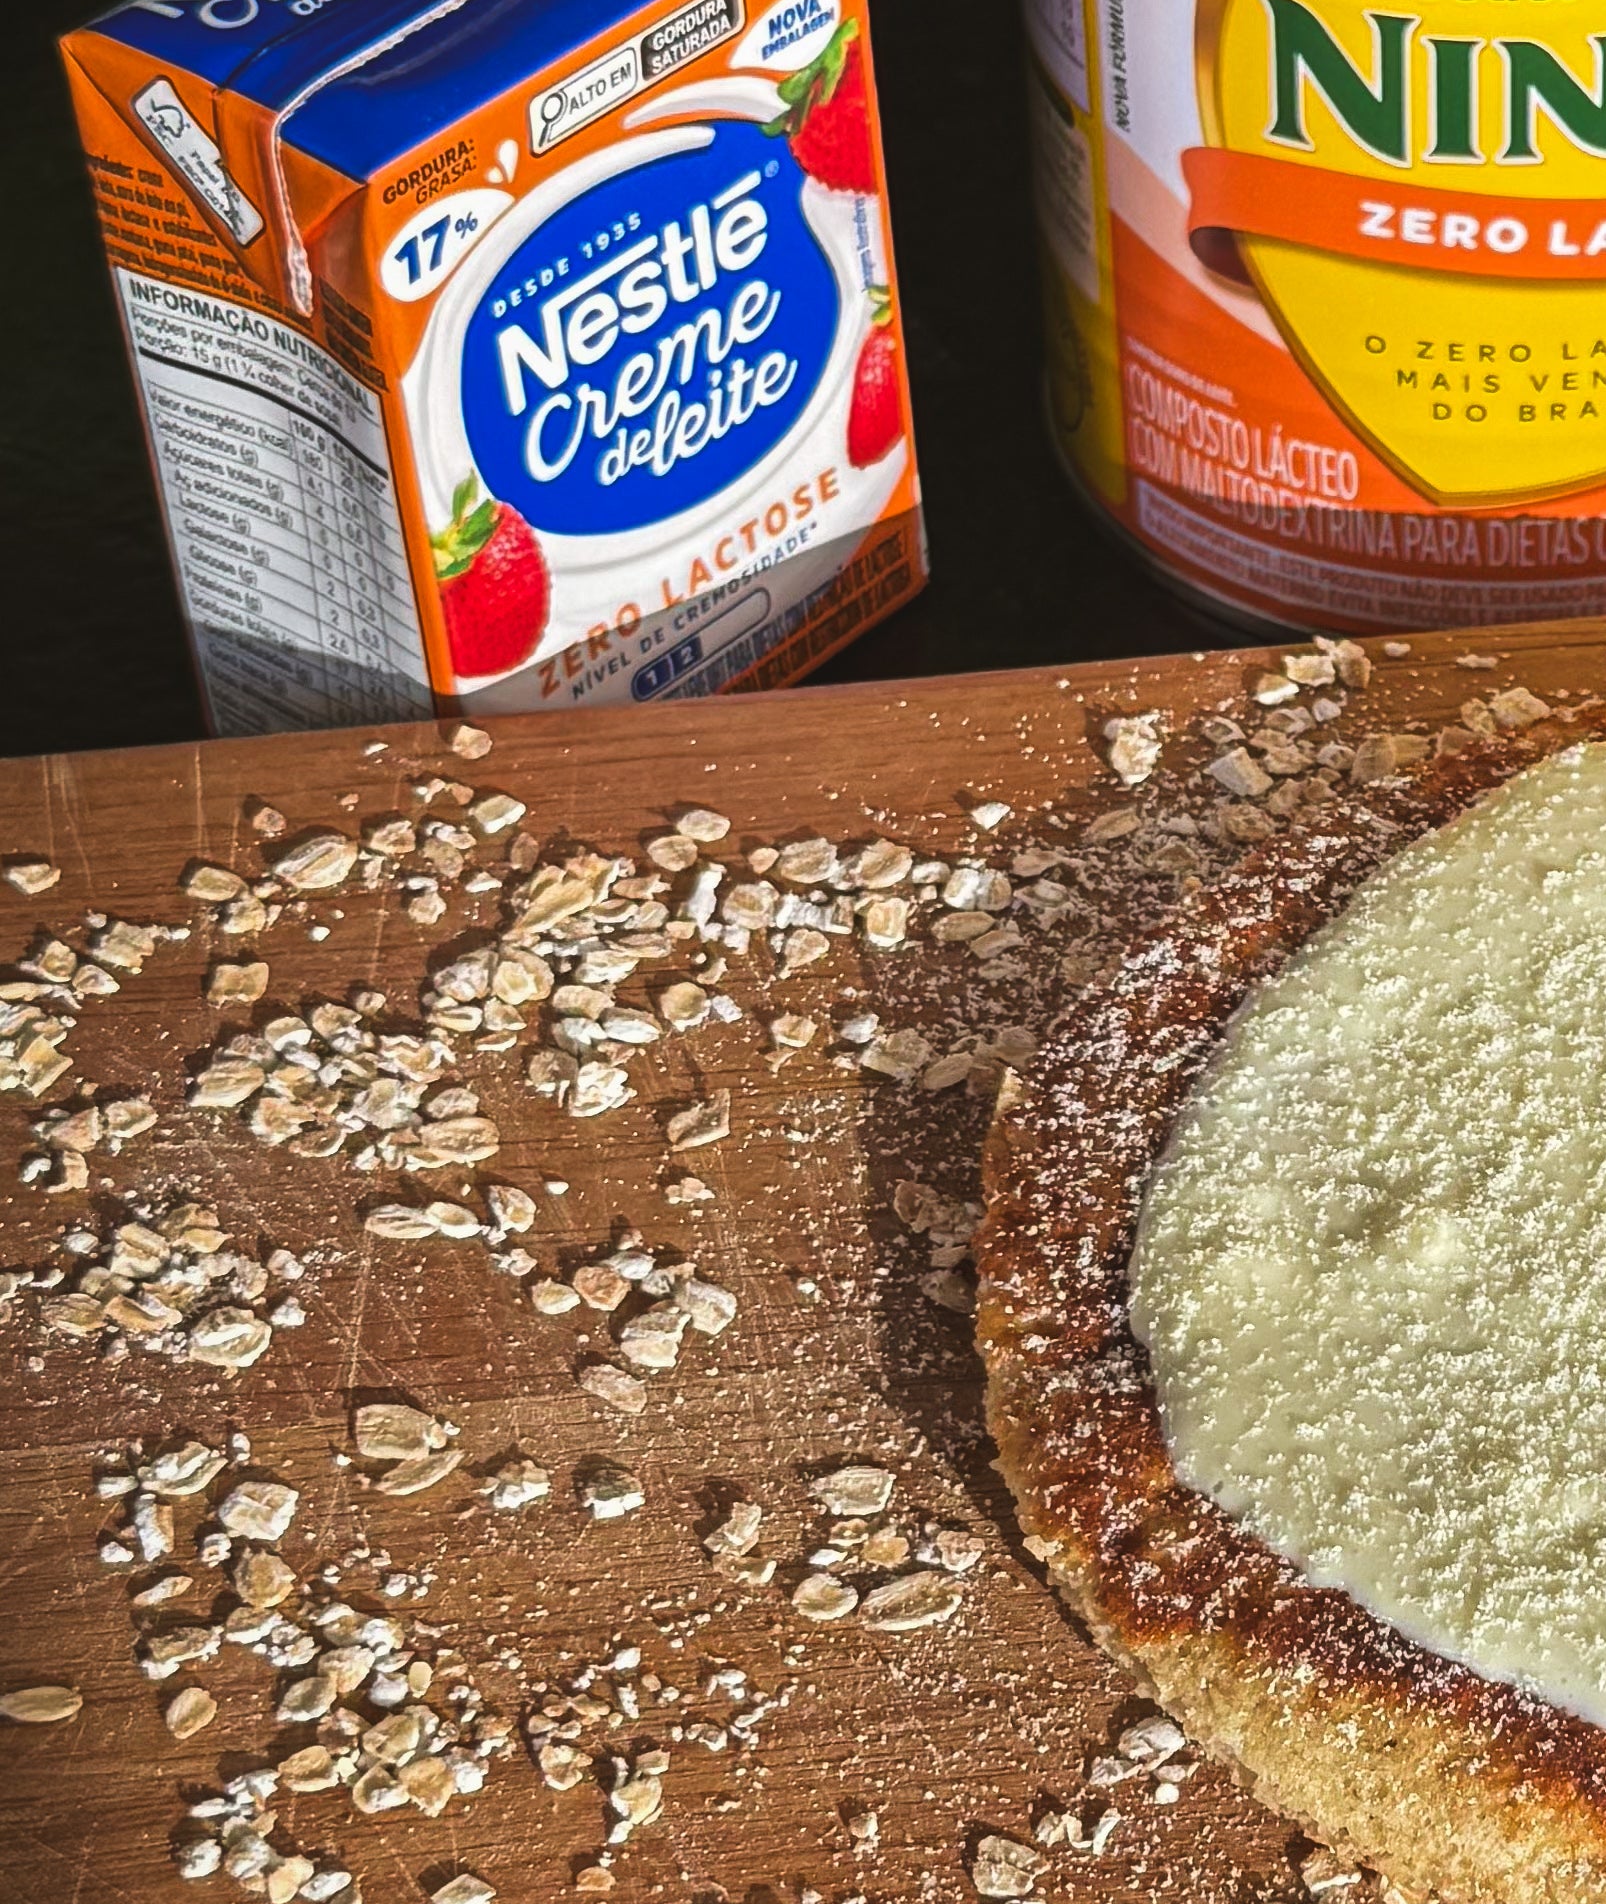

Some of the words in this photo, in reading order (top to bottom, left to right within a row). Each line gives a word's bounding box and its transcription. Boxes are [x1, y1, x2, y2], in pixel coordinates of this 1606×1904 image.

[651, 15, 732, 76] SATURADA
[761, 7, 836, 61] EMBALAGEM
[568, 75, 607, 115] ALTO
[610, 61, 633, 89] EM
[383, 138, 476, 205] GORDURA:
[416, 157, 478, 205] GRASA:
[1358, 201, 1528, 256] ZERO
[492, 257, 571, 319] DESDE
[579, 212, 643, 259] 1935
[497, 170, 769, 417] Nestlé
[129, 278, 269, 340] INFORMAÇÃO
[273, 327, 375, 417] NUTRICIONAL
[193, 344, 210, 364] 15
[1365, 334, 1387, 355] O
[1416, 340, 1532, 363] ZERO
[526, 280, 782, 483] Creme
[1396, 369, 1501, 394] MAIS
[1125, 361, 1250, 470] COMPOSTO
[1253, 421, 1360, 501] LÁCTEO
[1432, 402, 1489, 423] DO
[1404, 514, 1482, 567] PARA
[1487, 515, 1590, 569] DIETAS
[536, 602, 642, 700] ZERO
[660, 466, 841, 606] LACTOSE
[572, 650, 632, 701] NÍVEL
[639, 628, 666, 653] DE
[645, 664, 660, 686] 1
[681, 645, 695, 666] 2
